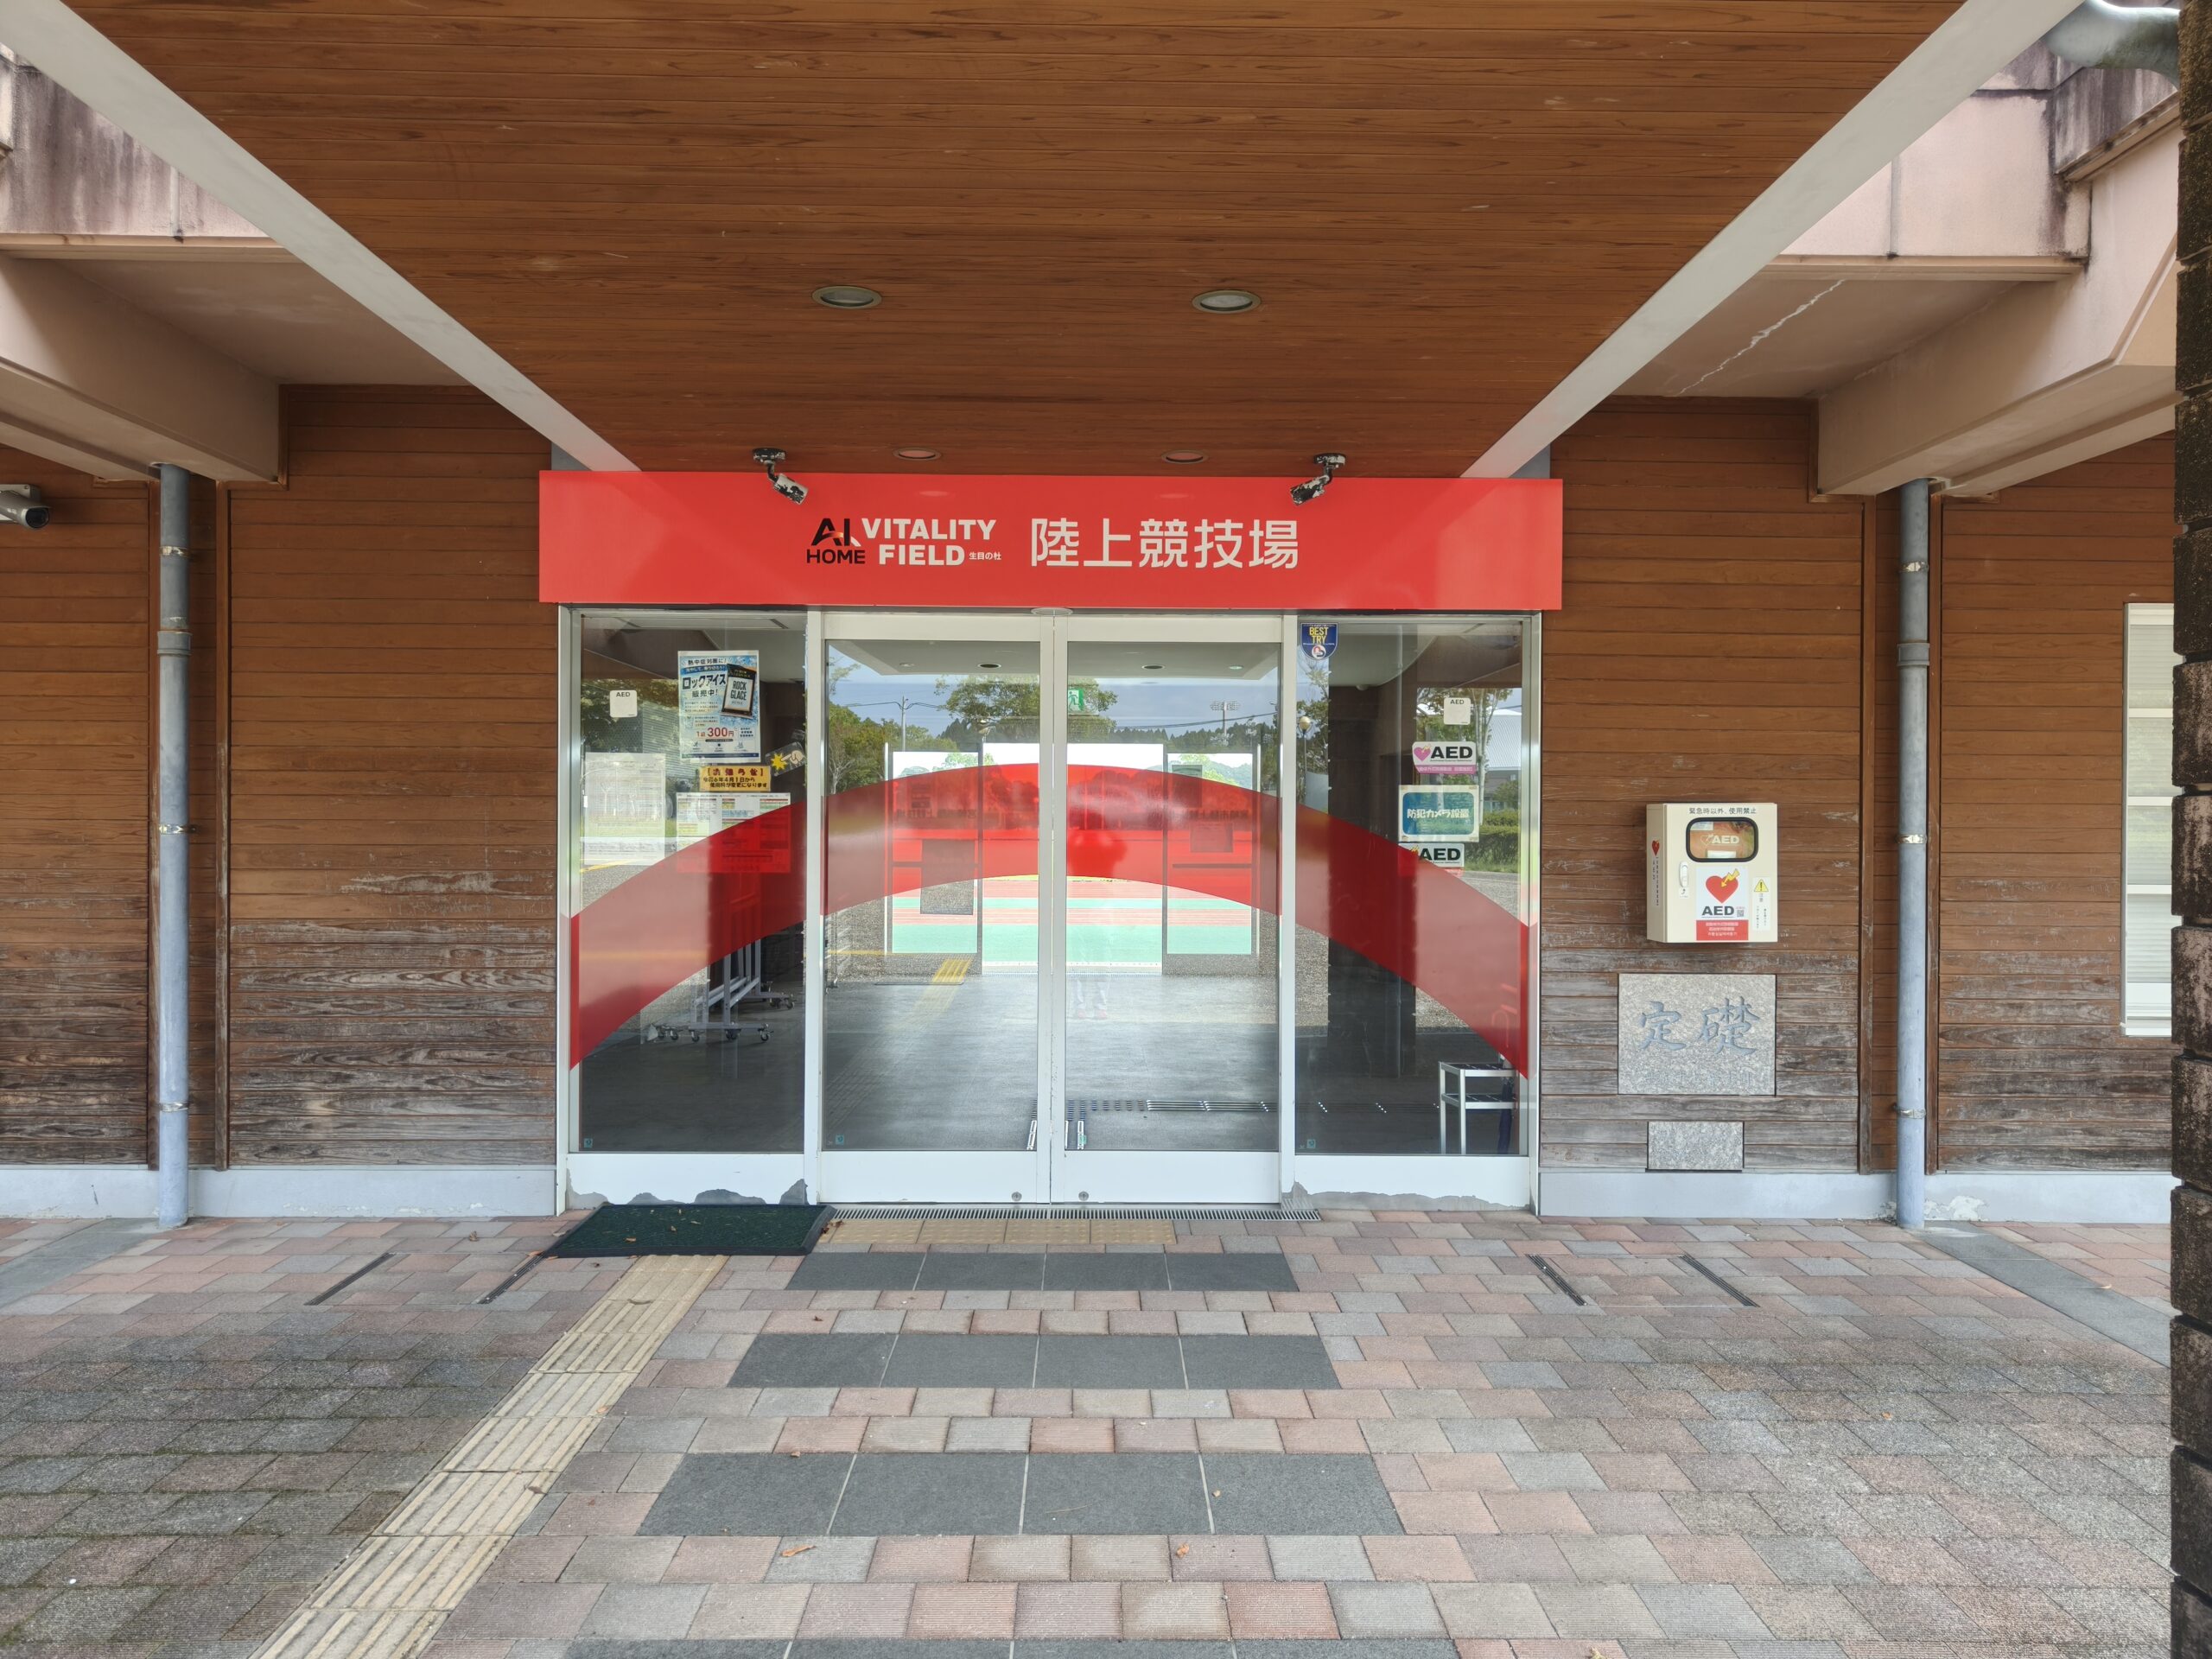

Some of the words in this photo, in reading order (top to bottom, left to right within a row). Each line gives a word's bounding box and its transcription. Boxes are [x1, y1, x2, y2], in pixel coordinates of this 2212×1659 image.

[861, 518, 996, 540] VITALITY
[1031, 518, 1299, 569] 陸上競技場
[806, 549, 866, 564] HOME
[879, 544, 965, 566] FIELD
[969, 551, 1002, 561] 生目の杜
[1309, 626, 1329, 636] BEST
[1312, 635, 1327, 645] TRY
[682, 674, 726, 690] ロックアイス
[733, 680, 747, 690] ROCK
[730, 690, 747, 701] GLACE
[707, 727, 734, 737] 300円
[1431, 747, 1473, 759] AED
[1712, 835, 1740, 844] AED
[1420, 848, 1461, 861] AED
[1701, 906, 1735, 916] AED
[1639, 995, 1761, 1056] 定礎
